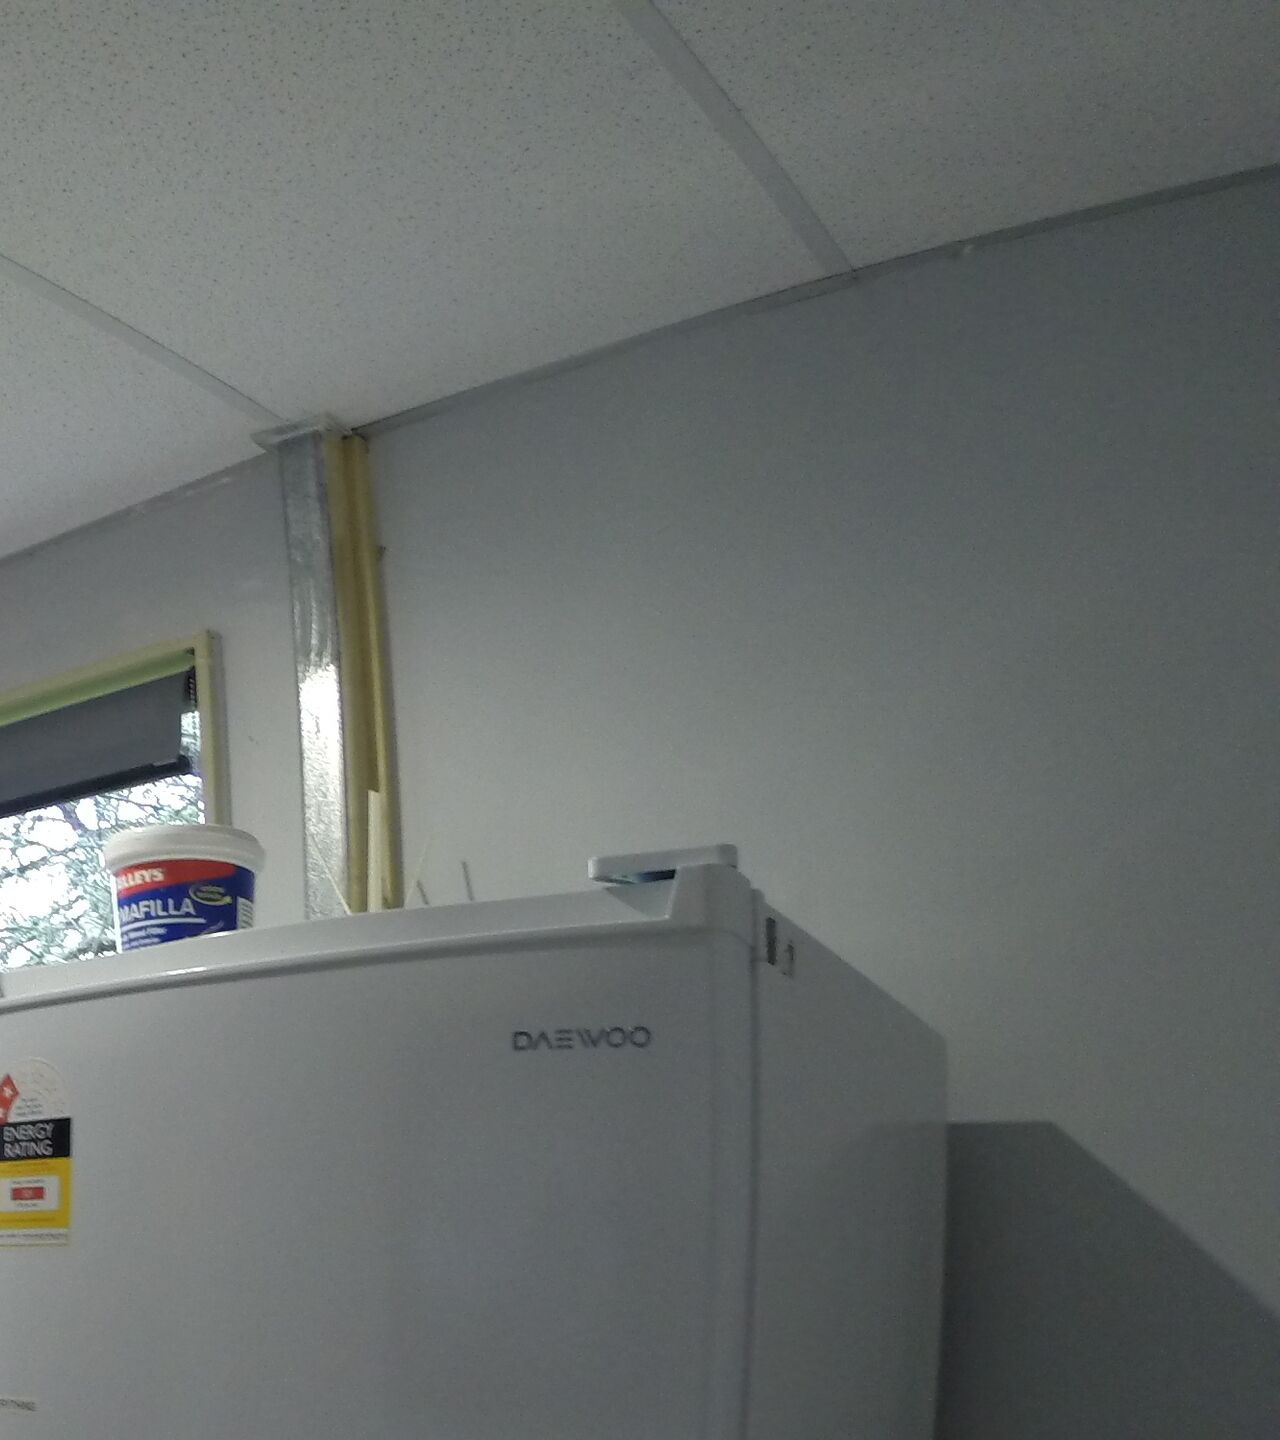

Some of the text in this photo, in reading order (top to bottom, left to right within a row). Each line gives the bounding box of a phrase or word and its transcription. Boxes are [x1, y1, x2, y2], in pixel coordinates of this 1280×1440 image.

[512, 1026, 652, 1051] DAEWOO
[3, 1122, 55, 1141] ENERGY
[3, 1139, 54, 1158] RATING
